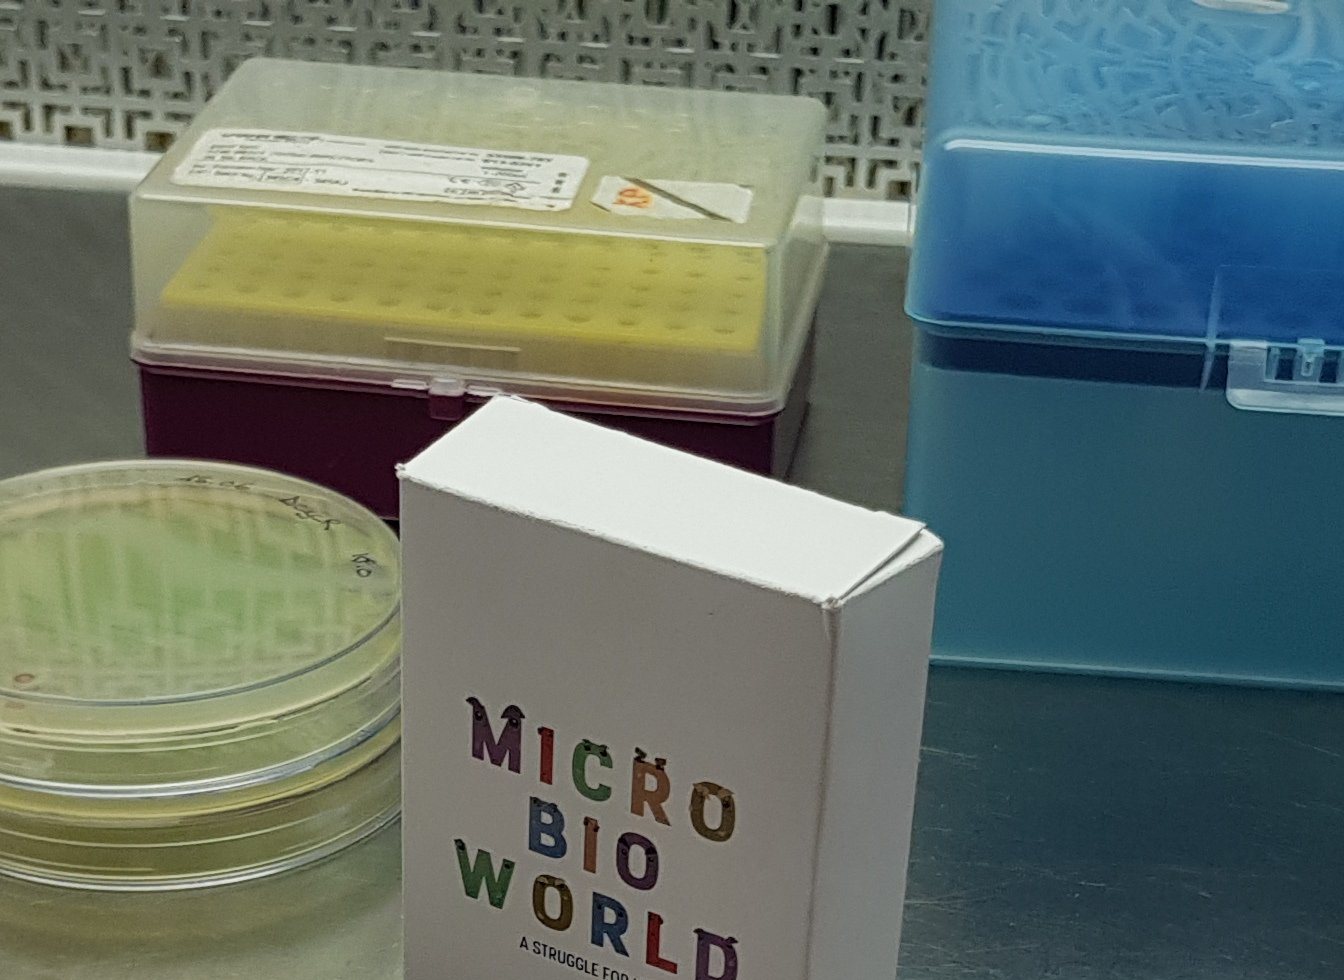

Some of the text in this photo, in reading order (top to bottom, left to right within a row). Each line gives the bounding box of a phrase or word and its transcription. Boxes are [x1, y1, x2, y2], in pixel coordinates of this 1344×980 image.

[465, 696, 735, 842] MICRO
[528, 796, 659, 890] BIO
[520, 936, 528, 950] A
[532, 941, 599, 977] STRUGGLE
